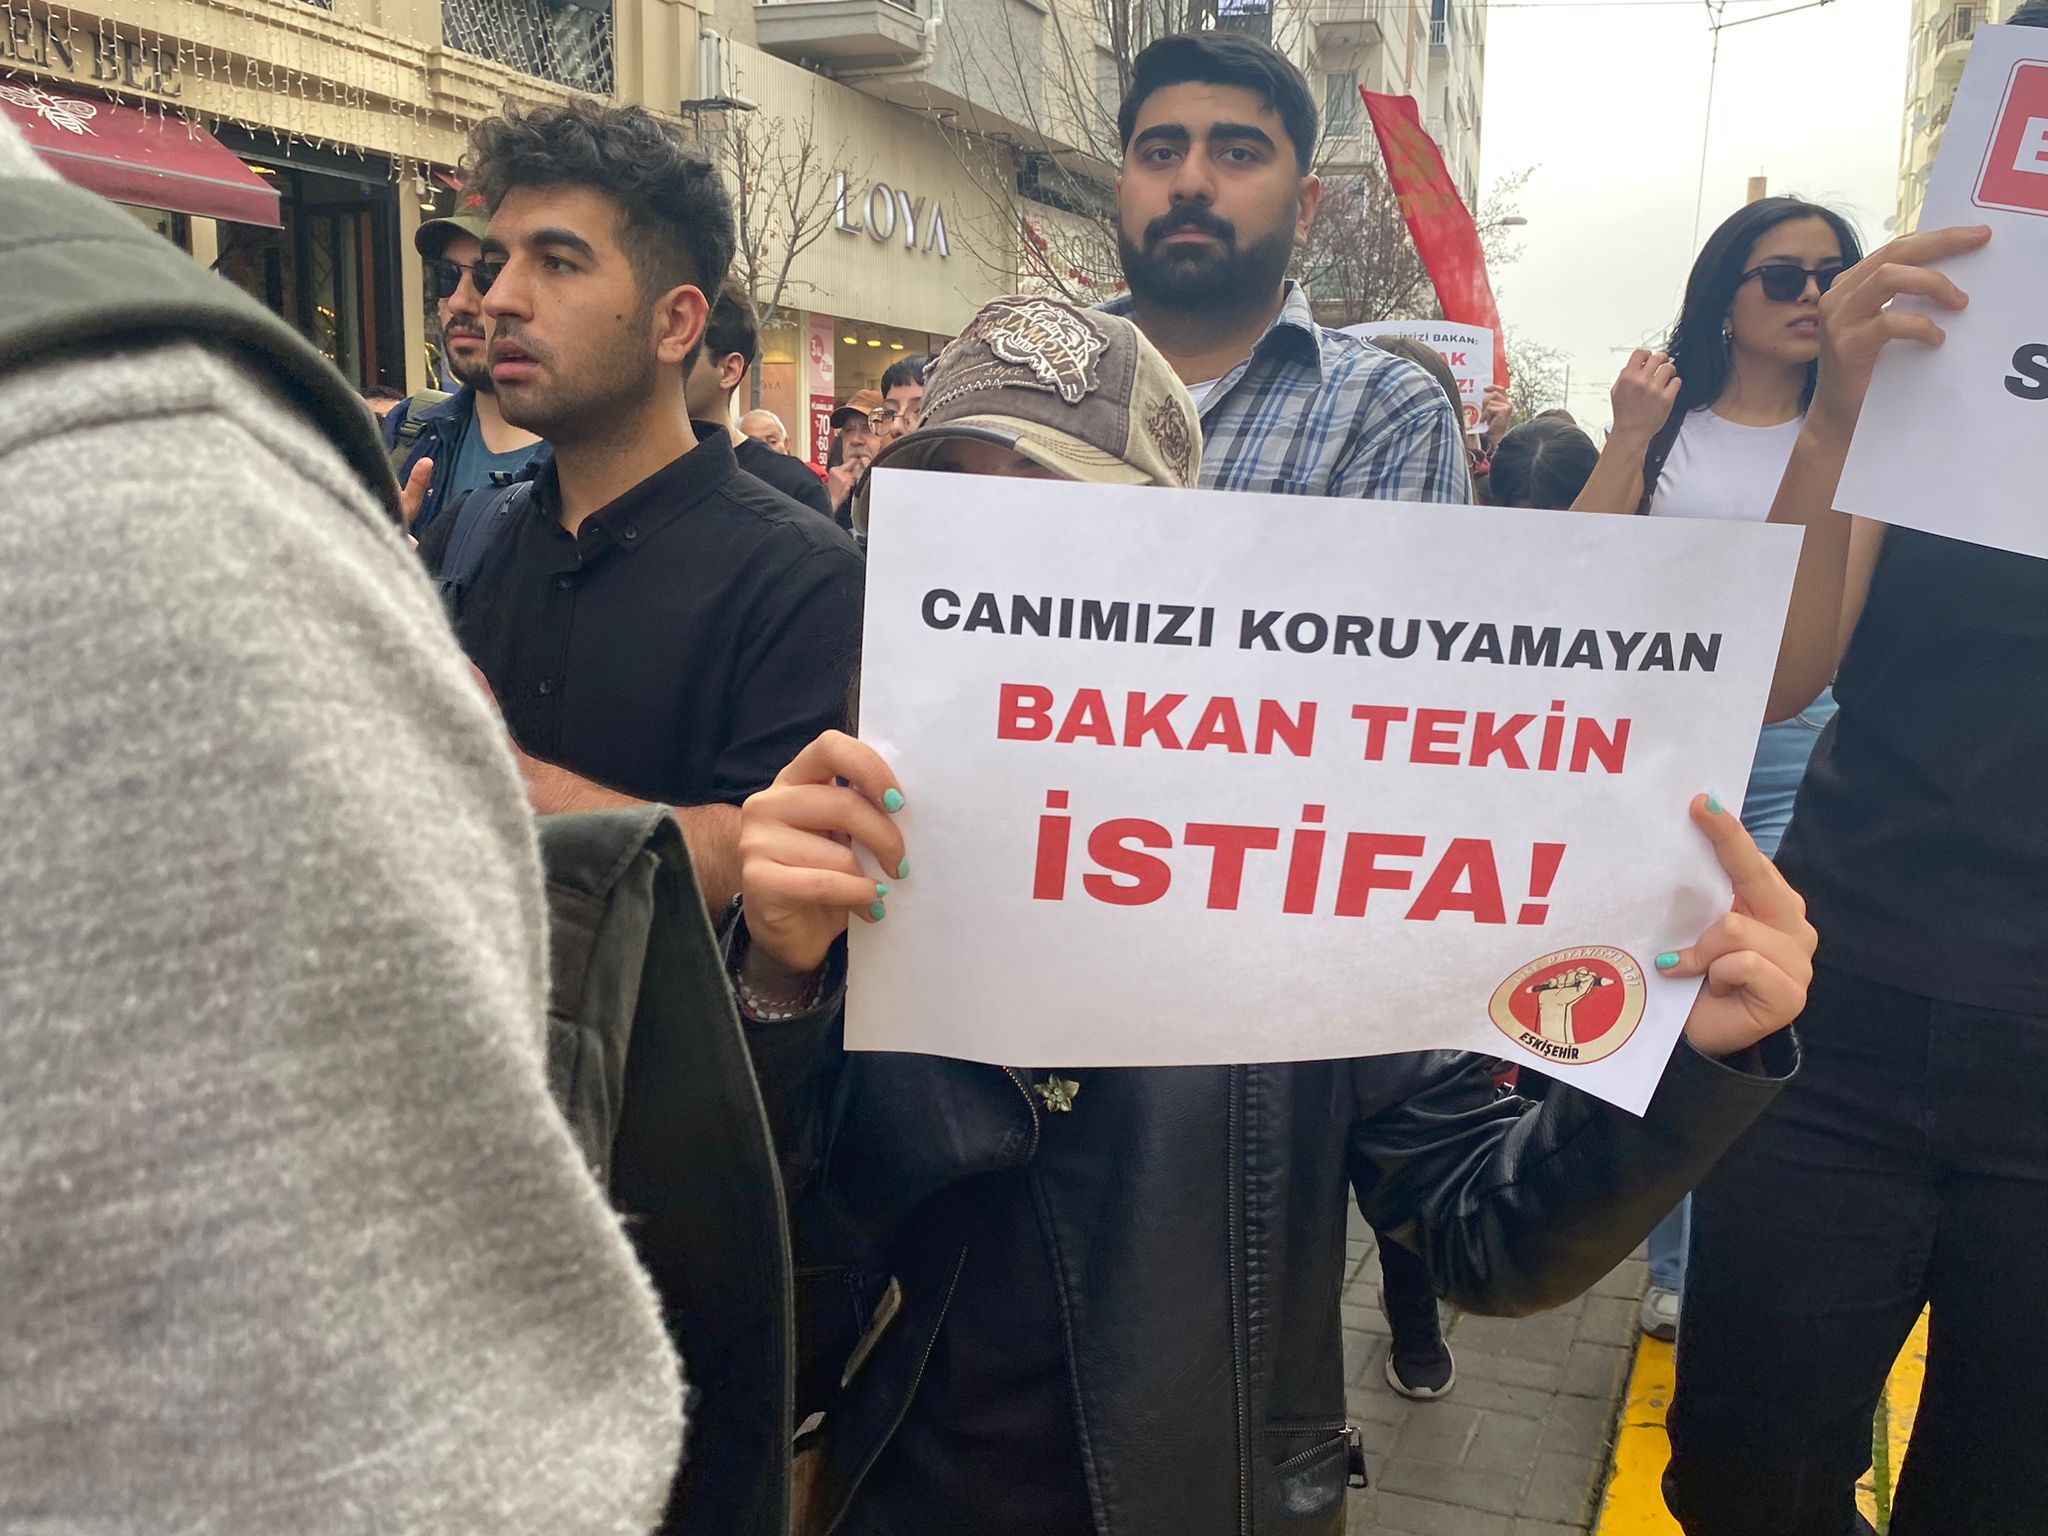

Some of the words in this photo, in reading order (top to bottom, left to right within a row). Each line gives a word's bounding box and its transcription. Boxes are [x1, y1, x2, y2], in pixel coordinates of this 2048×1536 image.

[0, 9, 76, 73] EN
[89, 31, 182, 98] BEE
[834, 169, 951, 257] LOYA
[921, 588, 1215, 647] CANIMIZI
[1238, 608, 1723, 673] KORUYAMAYAN
[997, 682, 1318, 757] BAKAN
[1350, 699, 1632, 774] TEKİN
[1033, 789, 1567, 926] İSTİFA!
[1518, 1032, 1580, 1060] ESKİŞEHİR
